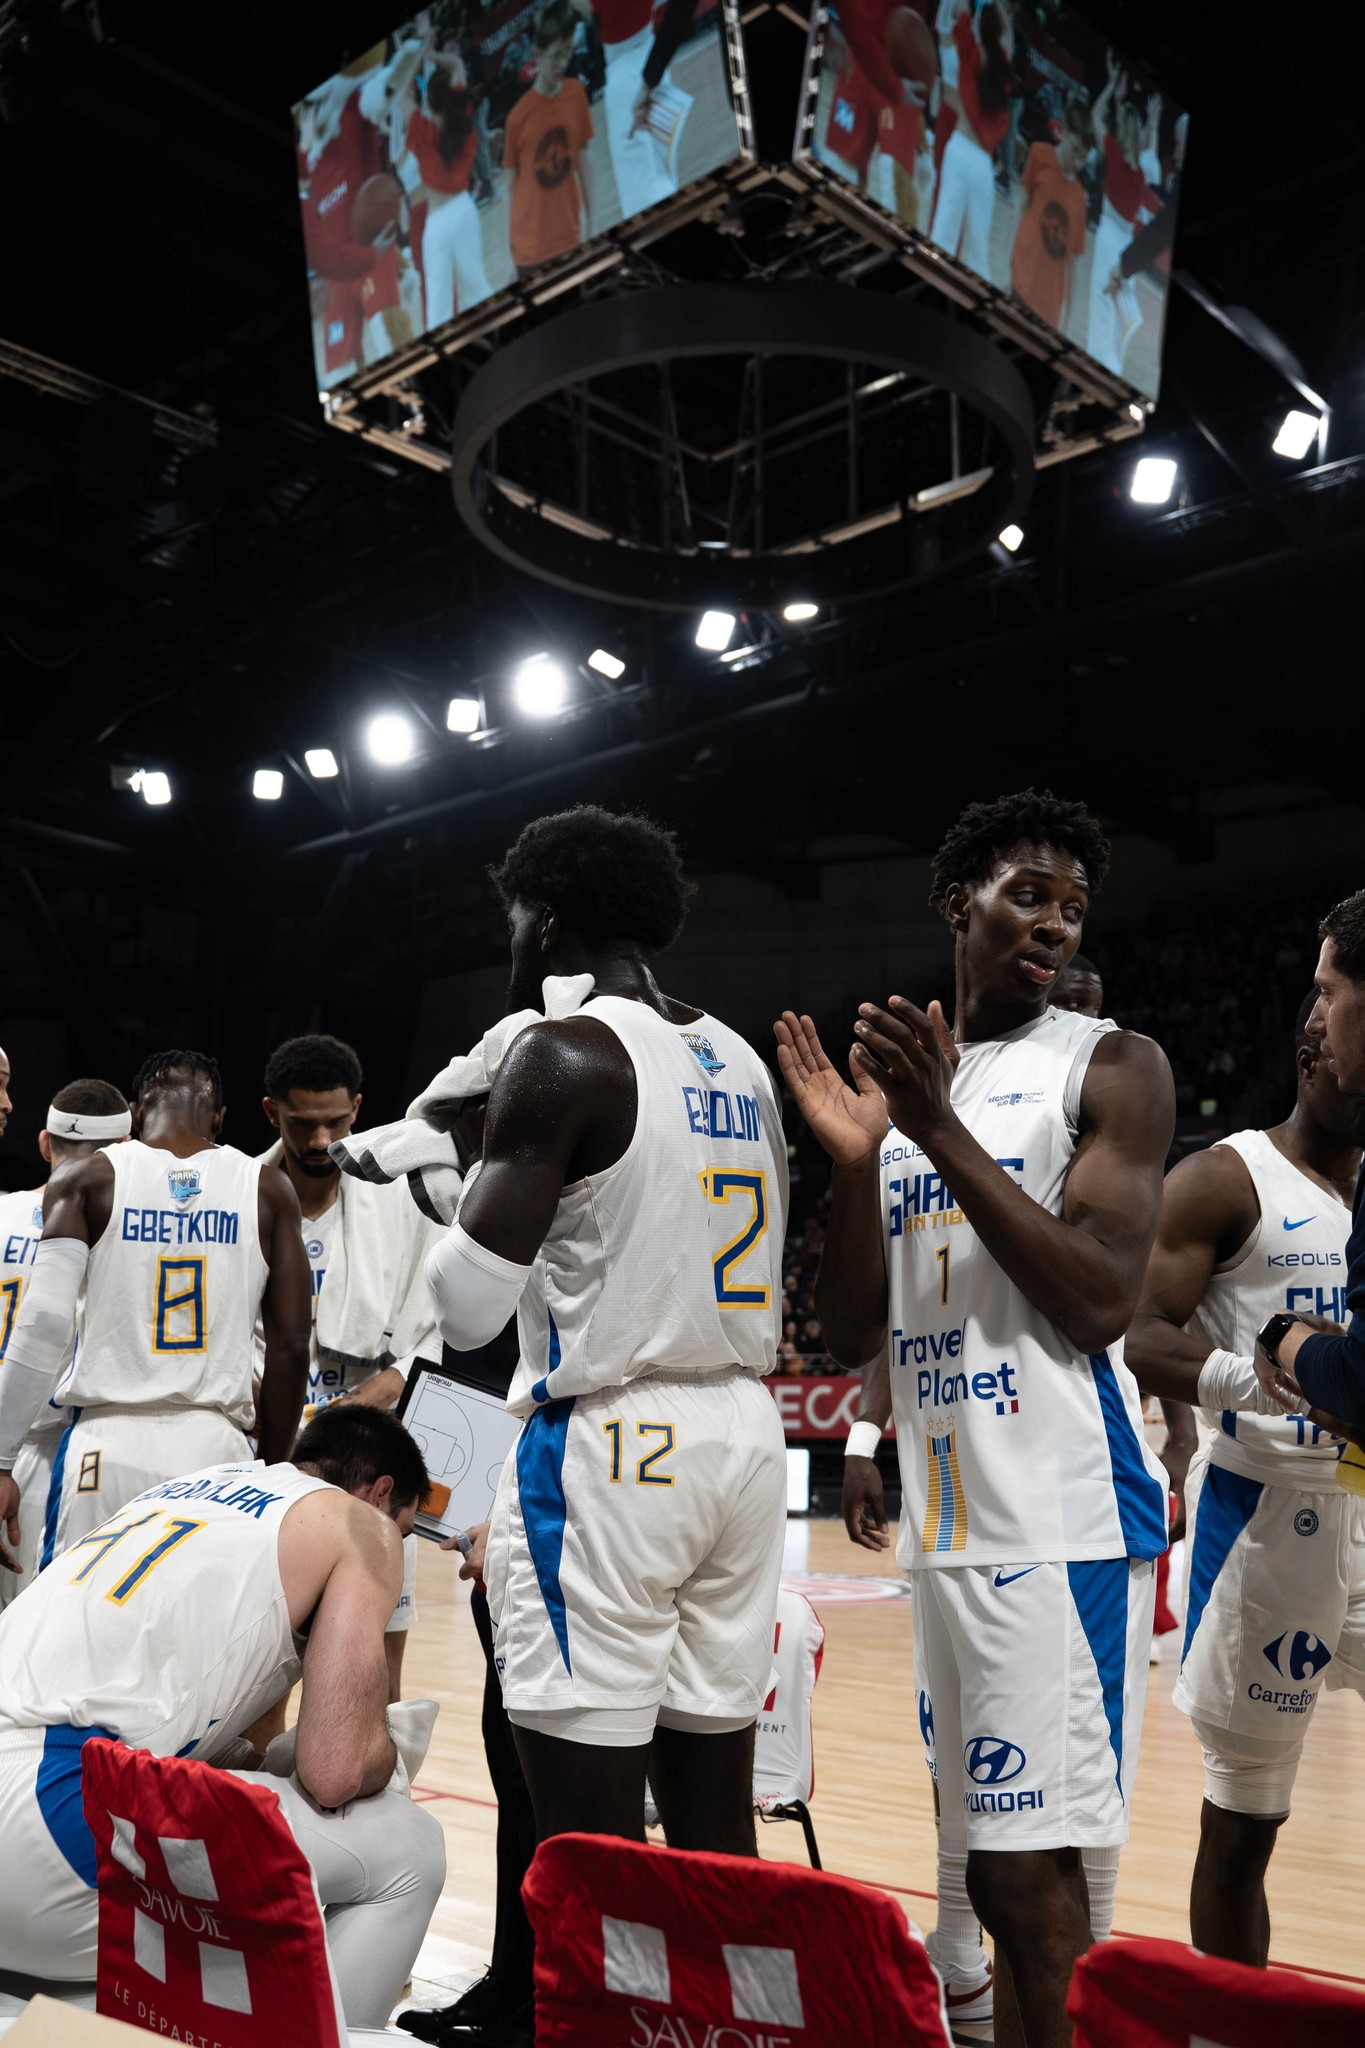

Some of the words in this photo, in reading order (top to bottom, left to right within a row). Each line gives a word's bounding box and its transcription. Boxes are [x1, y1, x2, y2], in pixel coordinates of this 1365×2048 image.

[122, 1207, 238, 1244] GBETKOM
[903, 1208, 970, 1235] ANTIB
[936, 1244, 950, 1307] 1
[152, 1255, 207, 1355] 8
[892, 1317, 967, 1367] Travel
[917, 1362, 1018, 1410] Planet
[76, 1449, 102, 1494] 8
[602, 1418, 677, 1487] 12
[132, 1875, 230, 1940] SAVOIE
[115, 1980, 130, 2006] LE
